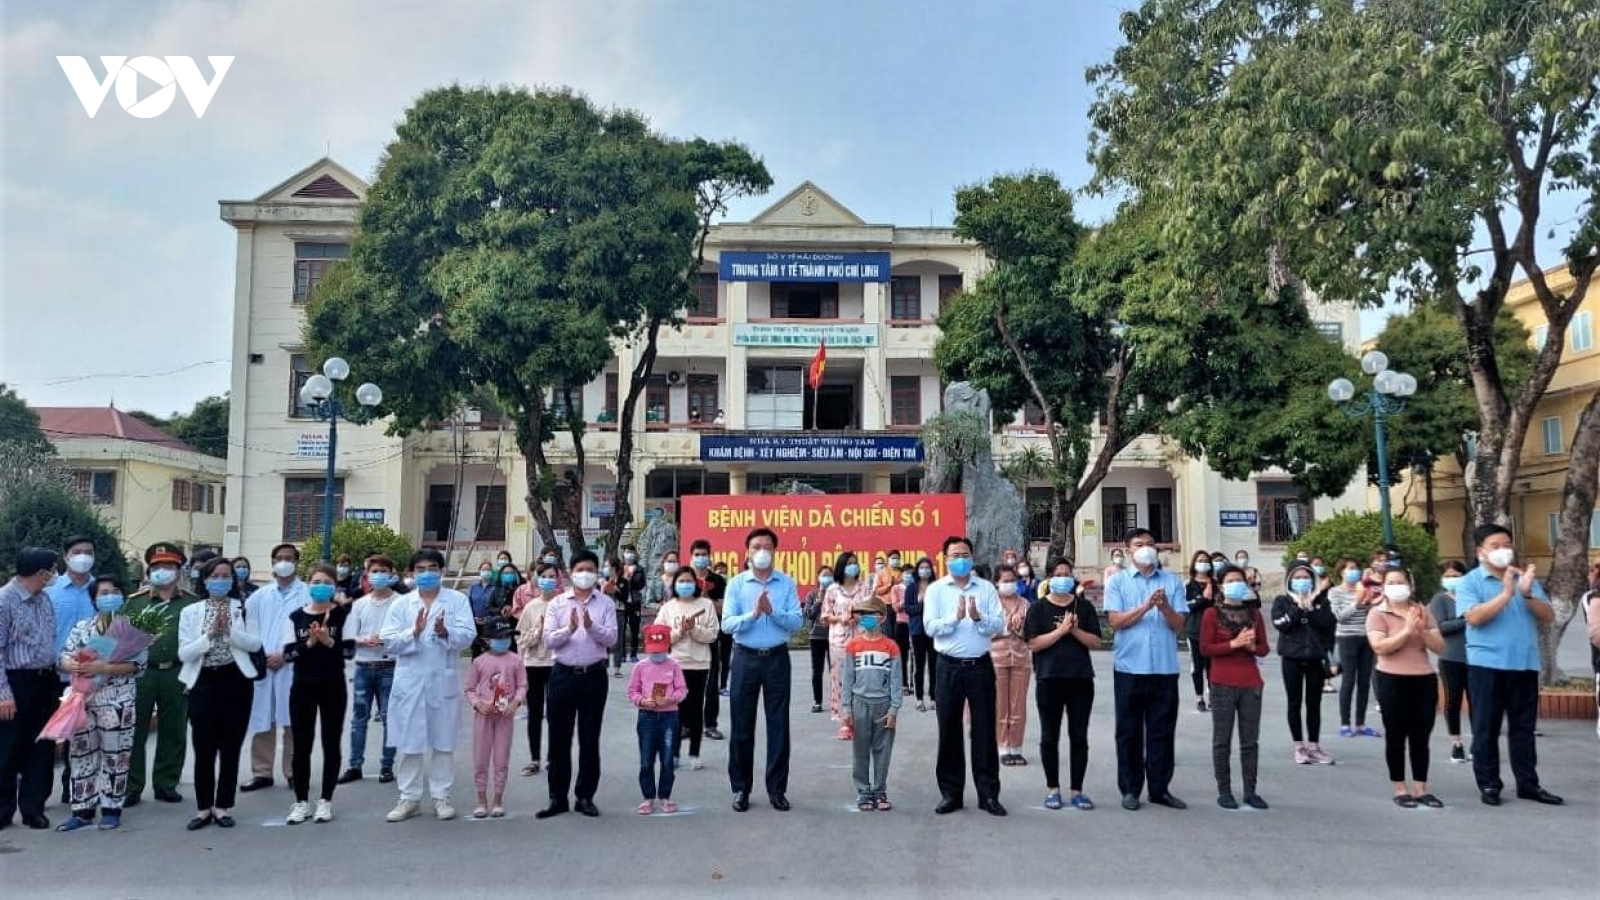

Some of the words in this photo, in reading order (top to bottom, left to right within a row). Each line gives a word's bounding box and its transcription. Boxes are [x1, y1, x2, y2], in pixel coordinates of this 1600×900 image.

[732, 264, 759, 278] TRUNG
[761, 261, 778, 278] TÂM
[780, 264, 786, 278] Y
[788, 261, 798, 278] TẾ
[799, 261, 826, 278] THÀNH
[828, 262, 844, 278] PHỐ
[845, 262, 860, 278] CHÍ
[861, 264, 879, 278] LINH
[708, 446, 732, 458] KHÁM
[734, 446, 755, 459] BỆNH
[760, 446, 773, 458] XÉT
[776, 446, 807, 459] NGHIỆM
[811, 446, 829, 458] SIÊU
[830, 446, 844, 458] ÂM
[847, 446, 862, 459] NỘI
[863, 447, 877, 458] SOI
[708, 505, 756, 533] BỆNH
[762, 505, 802, 533] VIỆN
[808, 505, 834, 528] DÃ
[841, 501, 894, 527] CHIẾN
[900, 501, 925, 526] SỐ
[931, 509, 940, 526] 1
